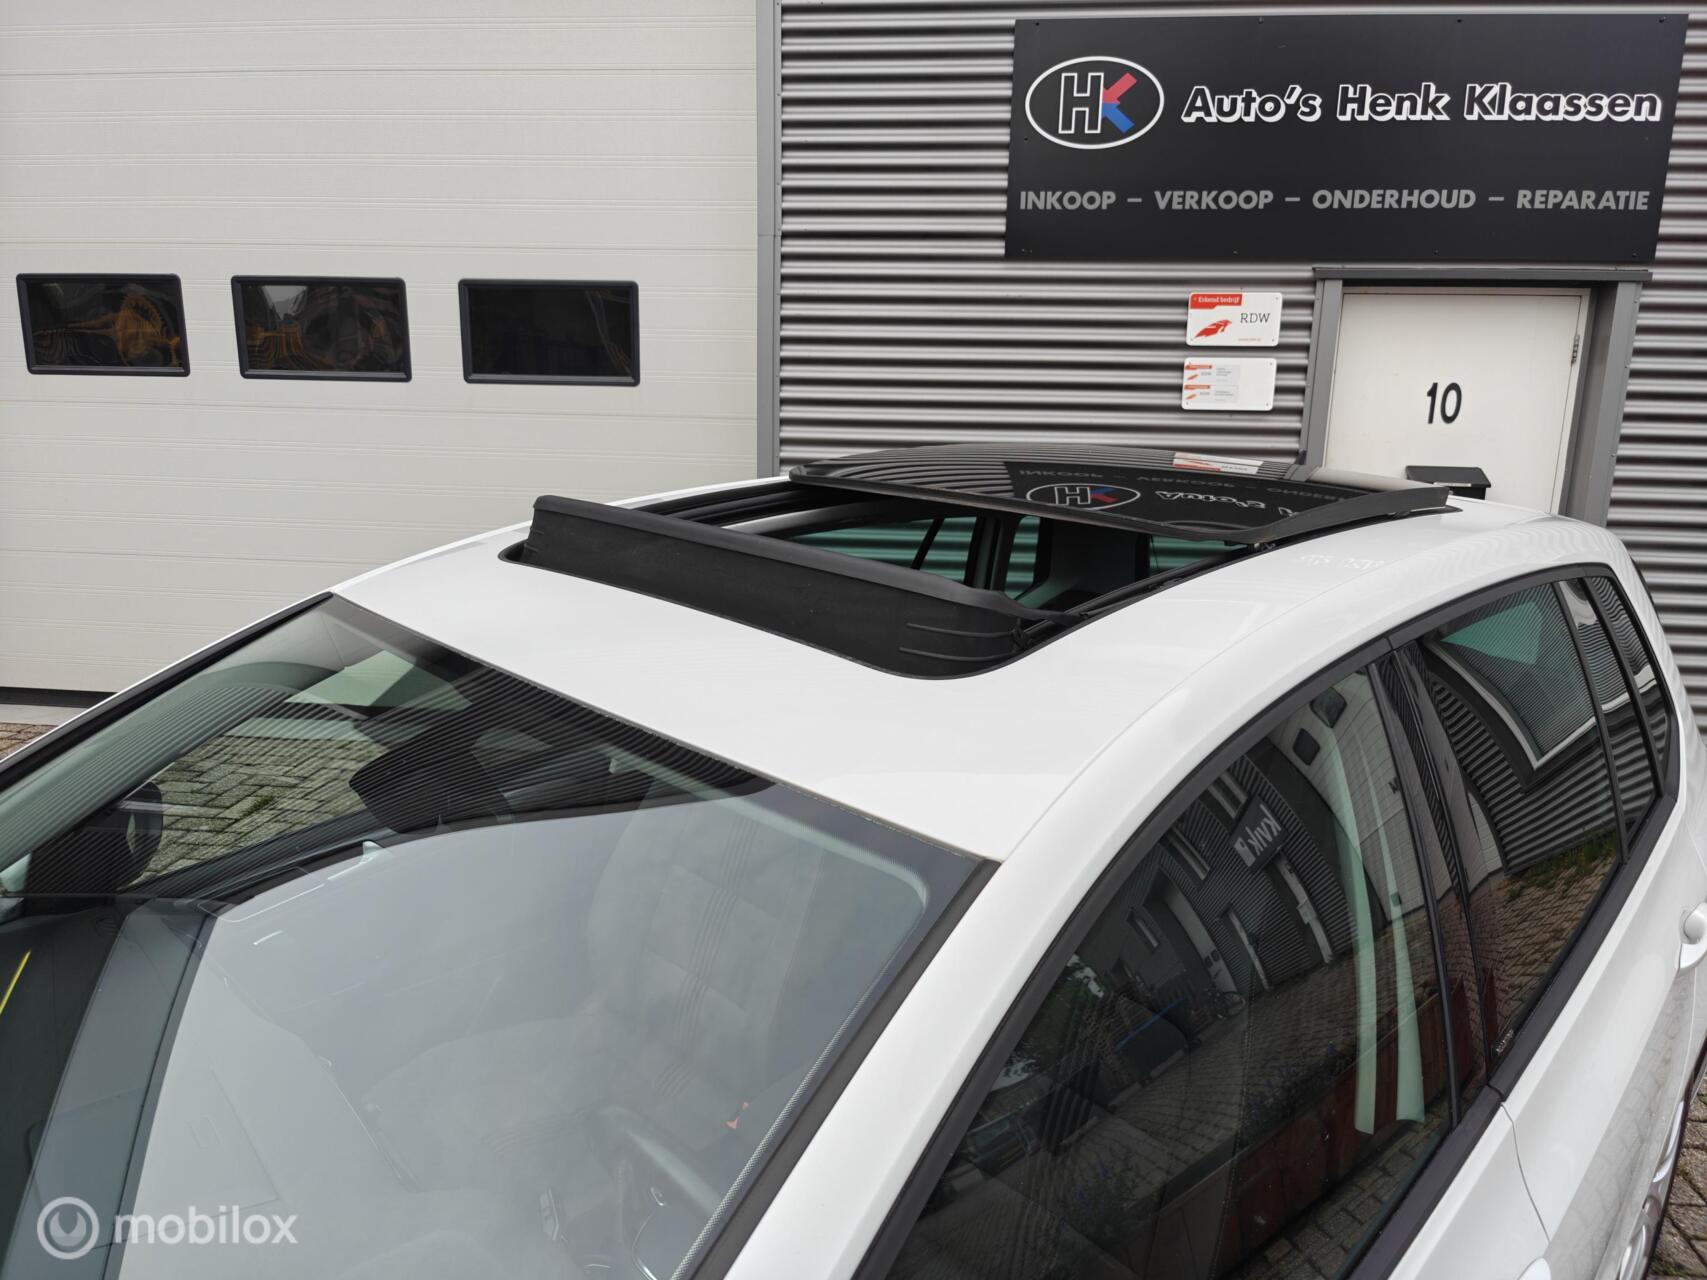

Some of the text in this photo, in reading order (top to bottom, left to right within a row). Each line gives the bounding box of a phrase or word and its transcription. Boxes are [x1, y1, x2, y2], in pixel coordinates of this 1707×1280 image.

[1181, 81, 1663, 123] Auto's Henk Klaassen
[1019, 190, 1117, 211] INKOOP
[1153, 189, 1274, 210] VERKOOP
[1312, 188, 1477, 210] ONDERHOUD
[1516, 189, 1651, 211] REPARATIE
[1240, 312, 1271, 324] RDW
[1426, 382, 1462, 424] 10
